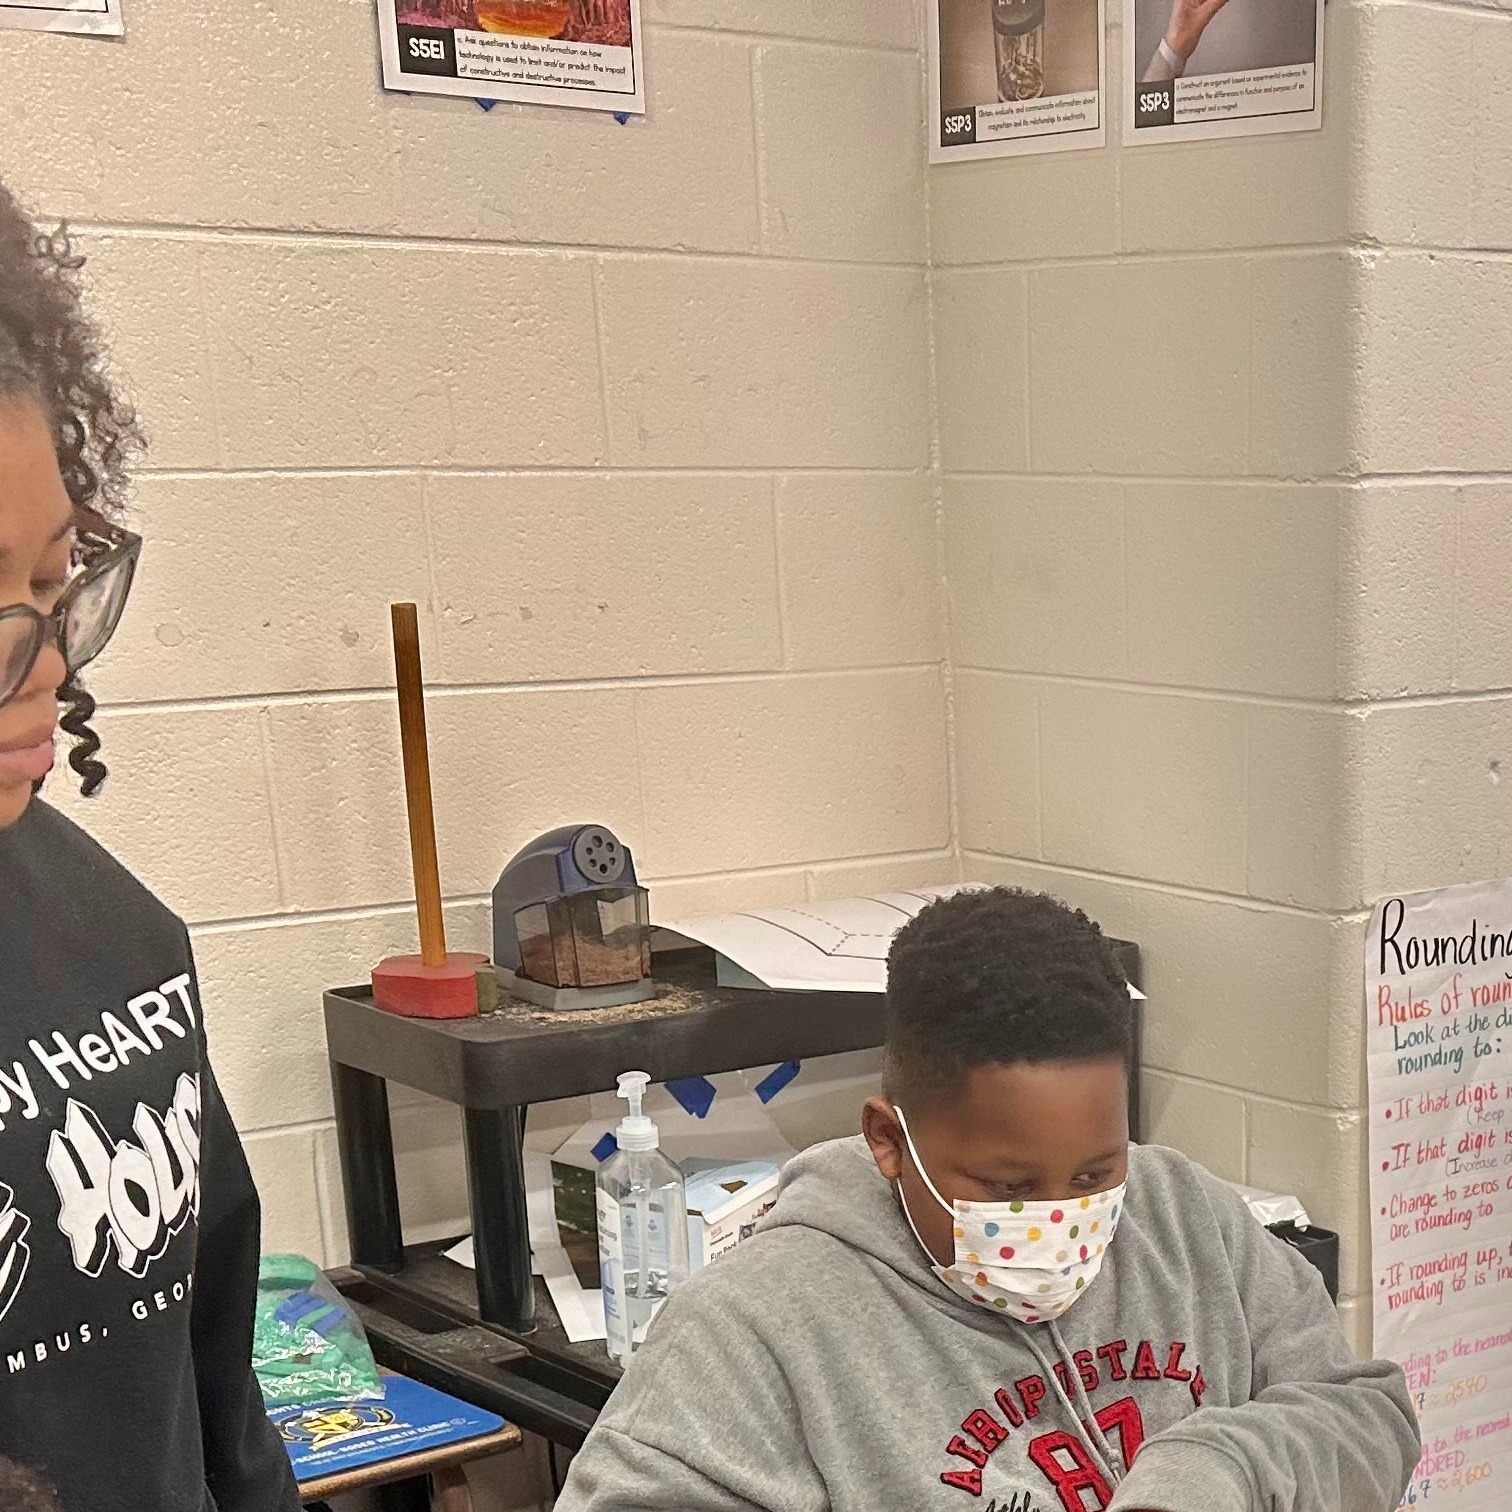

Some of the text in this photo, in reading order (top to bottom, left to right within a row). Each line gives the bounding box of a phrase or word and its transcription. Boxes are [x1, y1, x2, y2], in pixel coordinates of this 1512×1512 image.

[1140, 91, 1170, 113] S5P3
[945, 115, 972, 134] S5P3
[1378, 984, 1432, 1026] Rules
[1441, 973, 1463, 1015] of
[29, 973, 196, 1089] HeART
[1394, 1023, 1434, 1051] Look
[1441, 1021, 1460, 1037] at
[1465, 1014, 1490, 1033] the
[1398, 1036, 1502, 1075] rounding to:
[1390, 1194, 1437, 1218] Change
[1443, 1186, 1456, 1201] to
[1464, 1179, 1499, 1198] zeros
[1390, 1200, 1493, 1240] are rounding to
